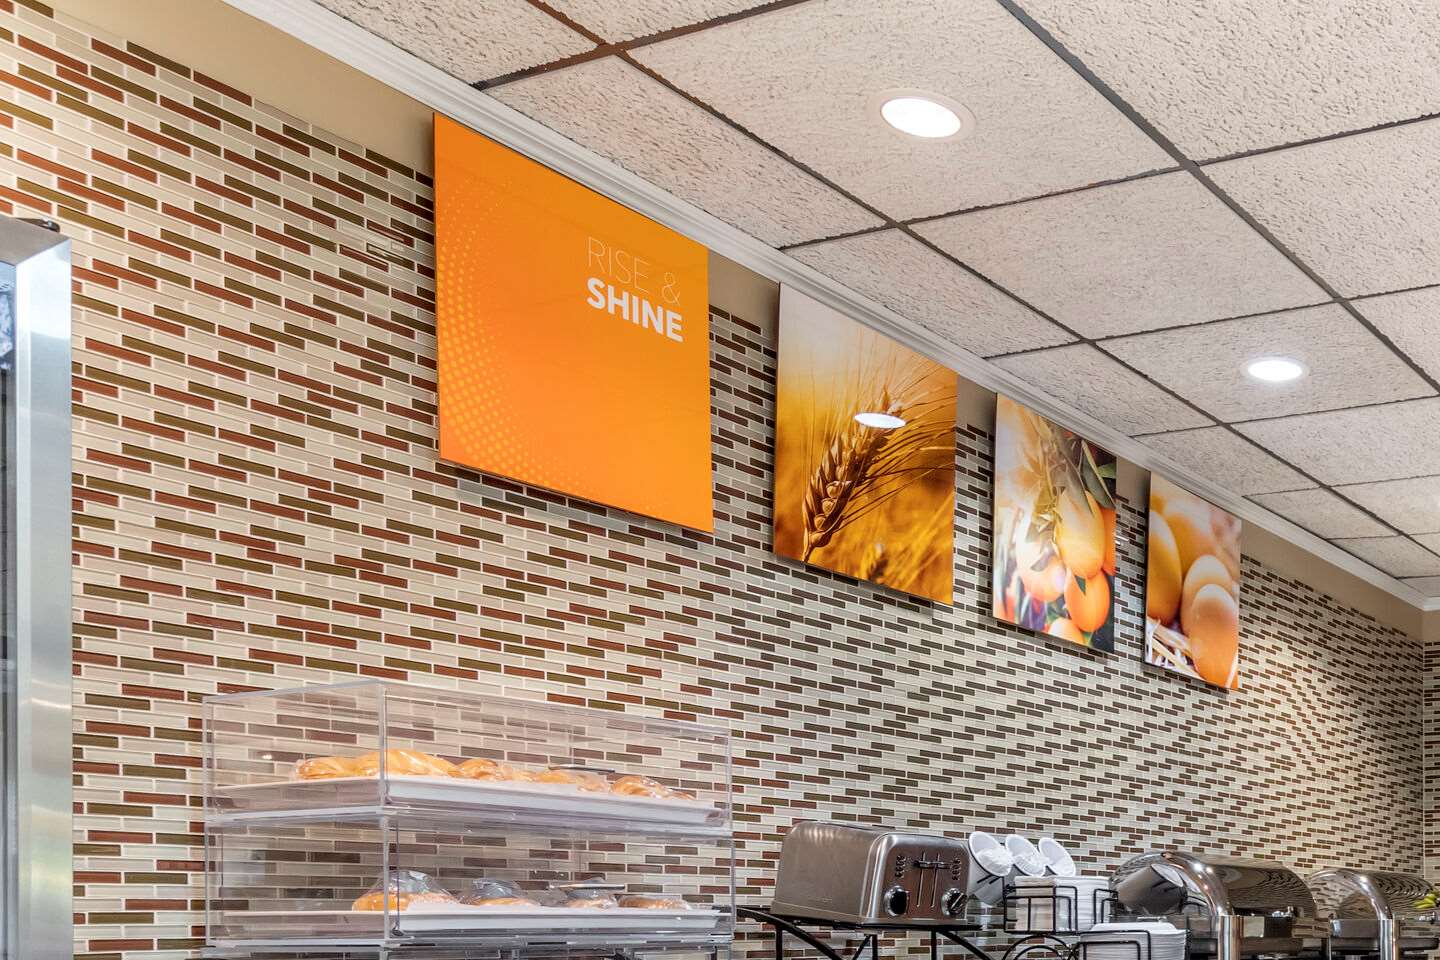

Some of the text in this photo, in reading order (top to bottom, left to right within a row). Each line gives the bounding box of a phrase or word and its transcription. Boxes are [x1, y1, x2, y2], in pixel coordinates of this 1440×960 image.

[587, 235, 682, 307] RISE &
[586, 276, 684, 343] SHINE
